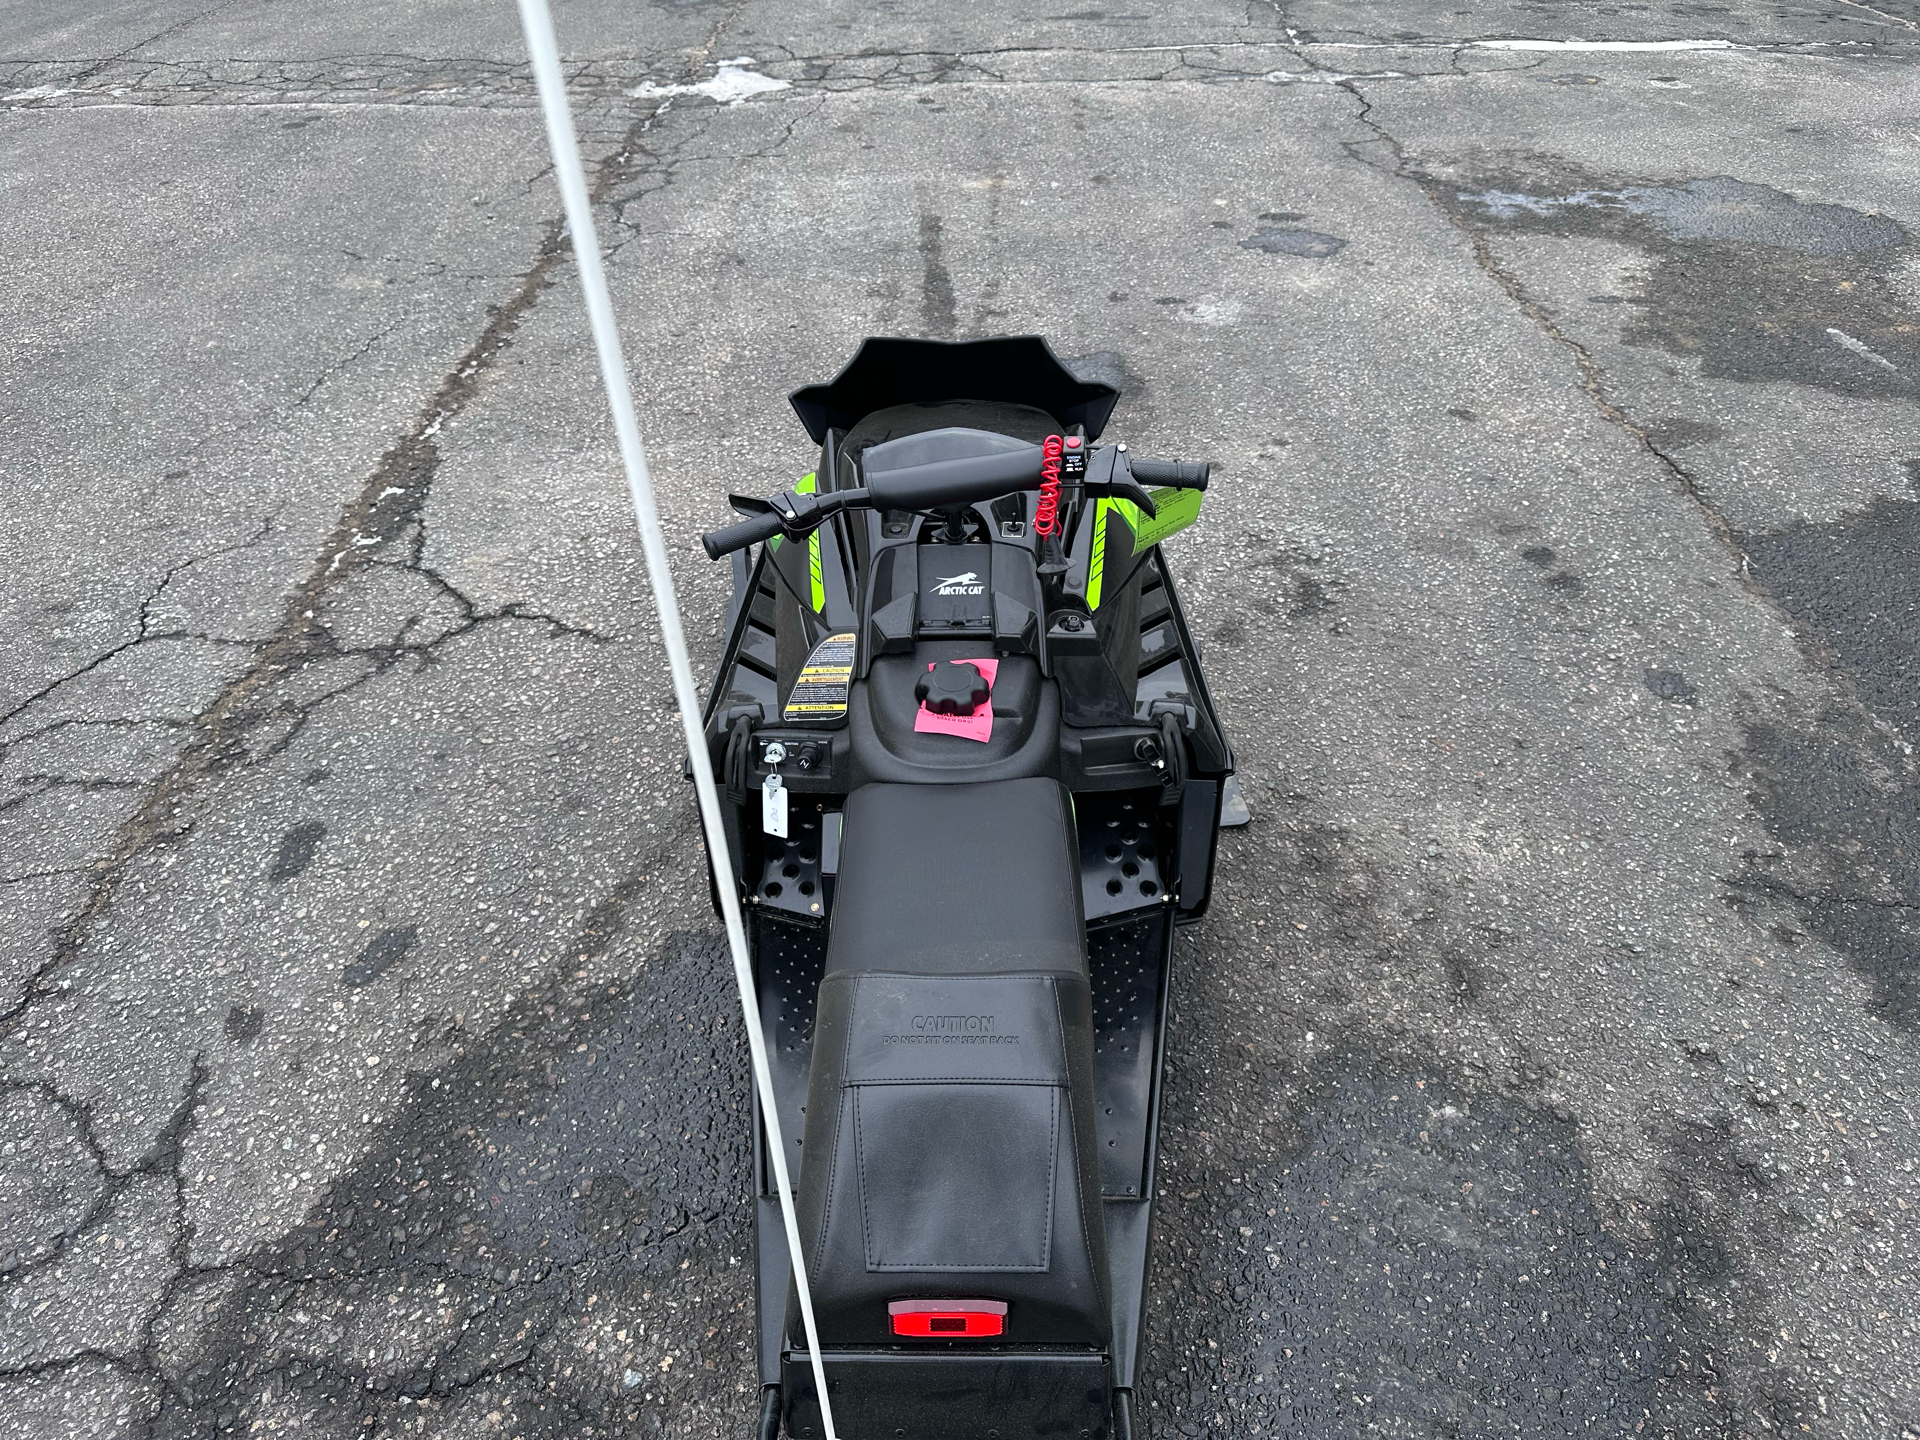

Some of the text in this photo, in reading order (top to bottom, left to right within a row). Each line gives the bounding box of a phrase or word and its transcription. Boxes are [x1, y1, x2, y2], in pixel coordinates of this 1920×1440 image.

[938, 586, 986, 596] ARCTIC CAT
[911, 1015, 995, 1033] CAUTION
[882, 1035, 1020, 1046] DO NOT SIT ON SEAT BACK
